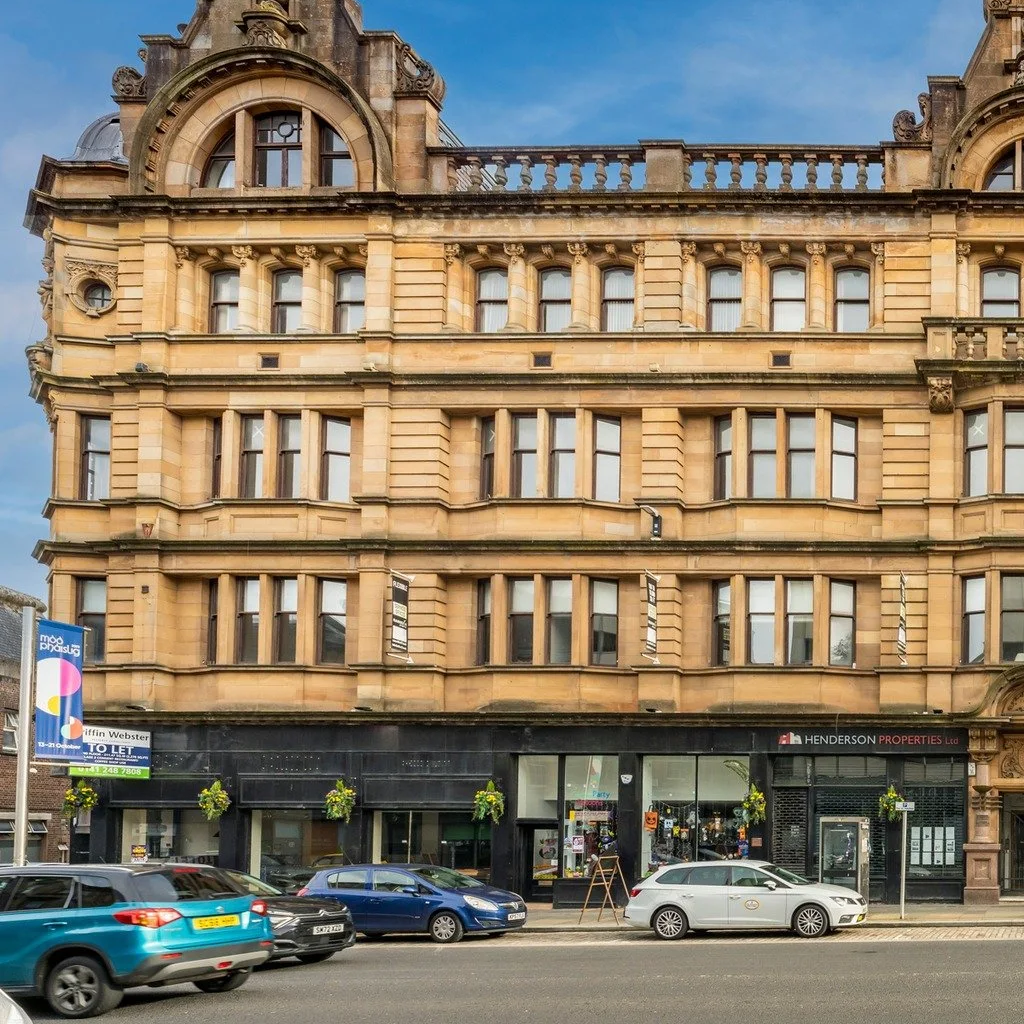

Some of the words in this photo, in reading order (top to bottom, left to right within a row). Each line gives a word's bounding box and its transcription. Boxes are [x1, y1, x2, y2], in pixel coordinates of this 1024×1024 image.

[84, 728, 105, 737] iffin
[108, 730, 149, 741] Webster
[804, 735, 876, 745] HENDERSON
[878, 735, 942, 745] PROPERTIES
[945, 736, 959, 745] Ltd
[56, 742, 81, 750] October
[88, 742, 107, 754] TO
[111, 745, 135, 756] LET
[592, 790, 610, 799] Party
